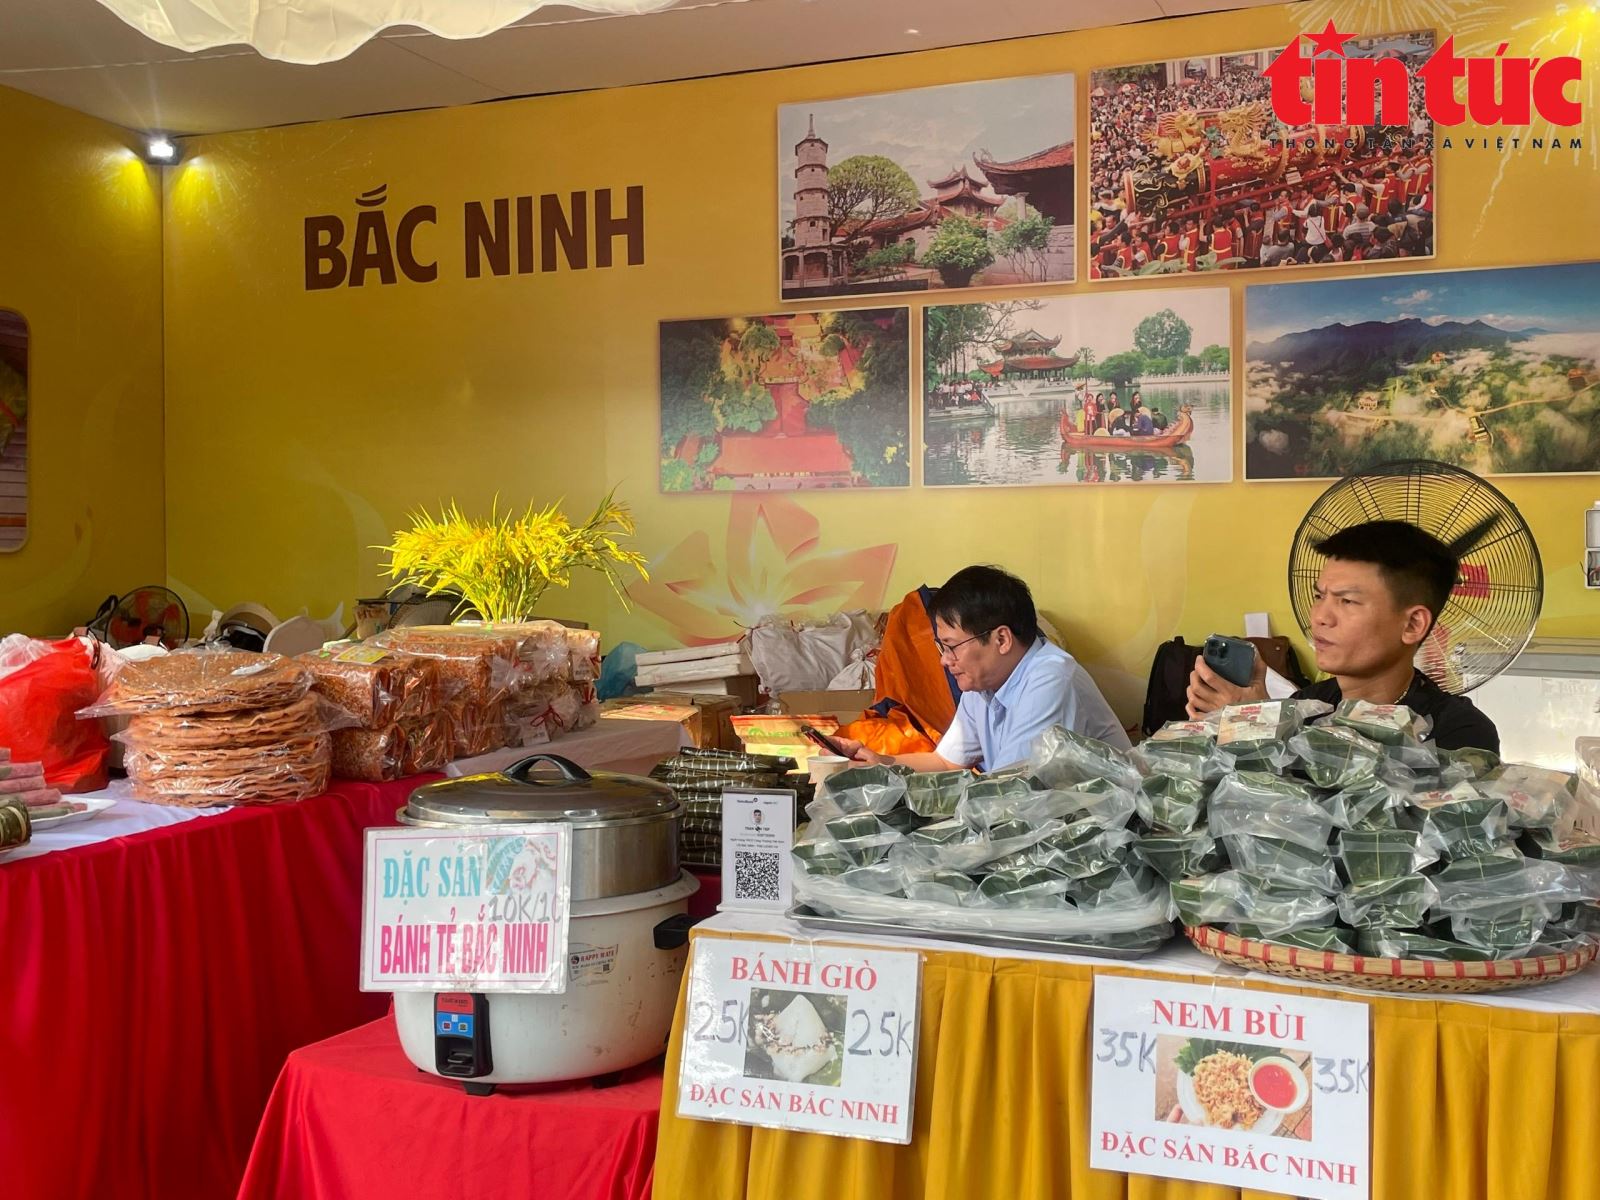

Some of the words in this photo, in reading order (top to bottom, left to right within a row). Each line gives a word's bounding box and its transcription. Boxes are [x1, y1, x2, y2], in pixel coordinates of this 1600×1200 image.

[304, 183, 438, 290] BẮC
[464, 185, 645, 279] NINH
[383, 850, 430, 905] ĐẶC
[438, 843, 482, 897] SẢN
[380, 914, 431, 974] BÁNH
[437, 907, 457, 974] TẺ
[461, 904, 498, 974] BẮC
[502, 923, 549, 974] NINH
[730, 952, 812, 986] BÁNH
[820, 960, 878, 991] GIÒ
[693, 999, 751, 1048] 25K
[848, 1009, 912, 1057] 25K
[1152, 999, 1232, 1033] NEM
[1243, 1005, 1307, 1042] BÙI
[1097, 1028, 1157, 1075] 35K
[1314, 1056, 1368, 1095] 35K
[690, 1083, 736, 1109] ĐẶC
[740, 1085, 783, 1110] SẢN
[788, 1091, 834, 1117] BẮC
[840, 1100, 899, 1124] NINH
[1101, 1131, 1156, 1159] ĐẶC
[1163, 1135, 1215, 1164] SẢN
[1223, 1144, 1279, 1173] BẮC
[1286, 1155, 1358, 1186] NINH
